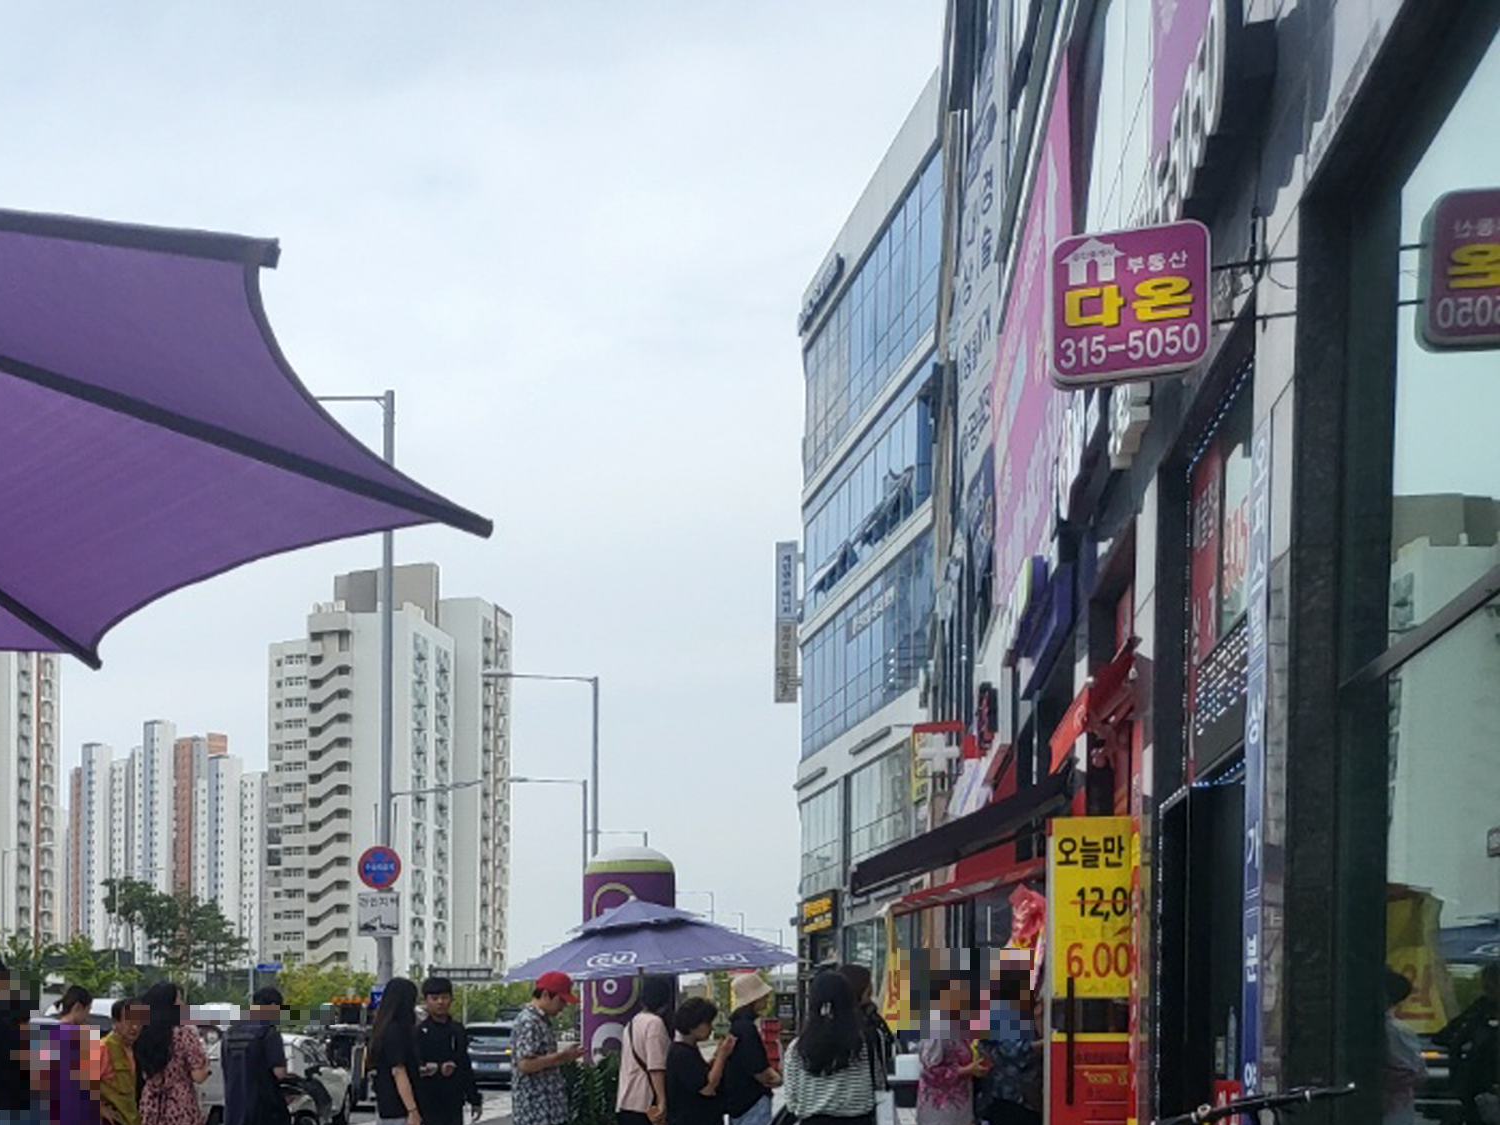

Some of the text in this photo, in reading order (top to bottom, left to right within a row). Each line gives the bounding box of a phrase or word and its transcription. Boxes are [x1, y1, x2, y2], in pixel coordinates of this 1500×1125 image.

[1126, 249, 1189, 275] 부동산
[1064, 276, 1194, 328] 다온
[1059, 322, 1201, 370] 315-5050
[1056, 835, 1124, 869] 오늘만
